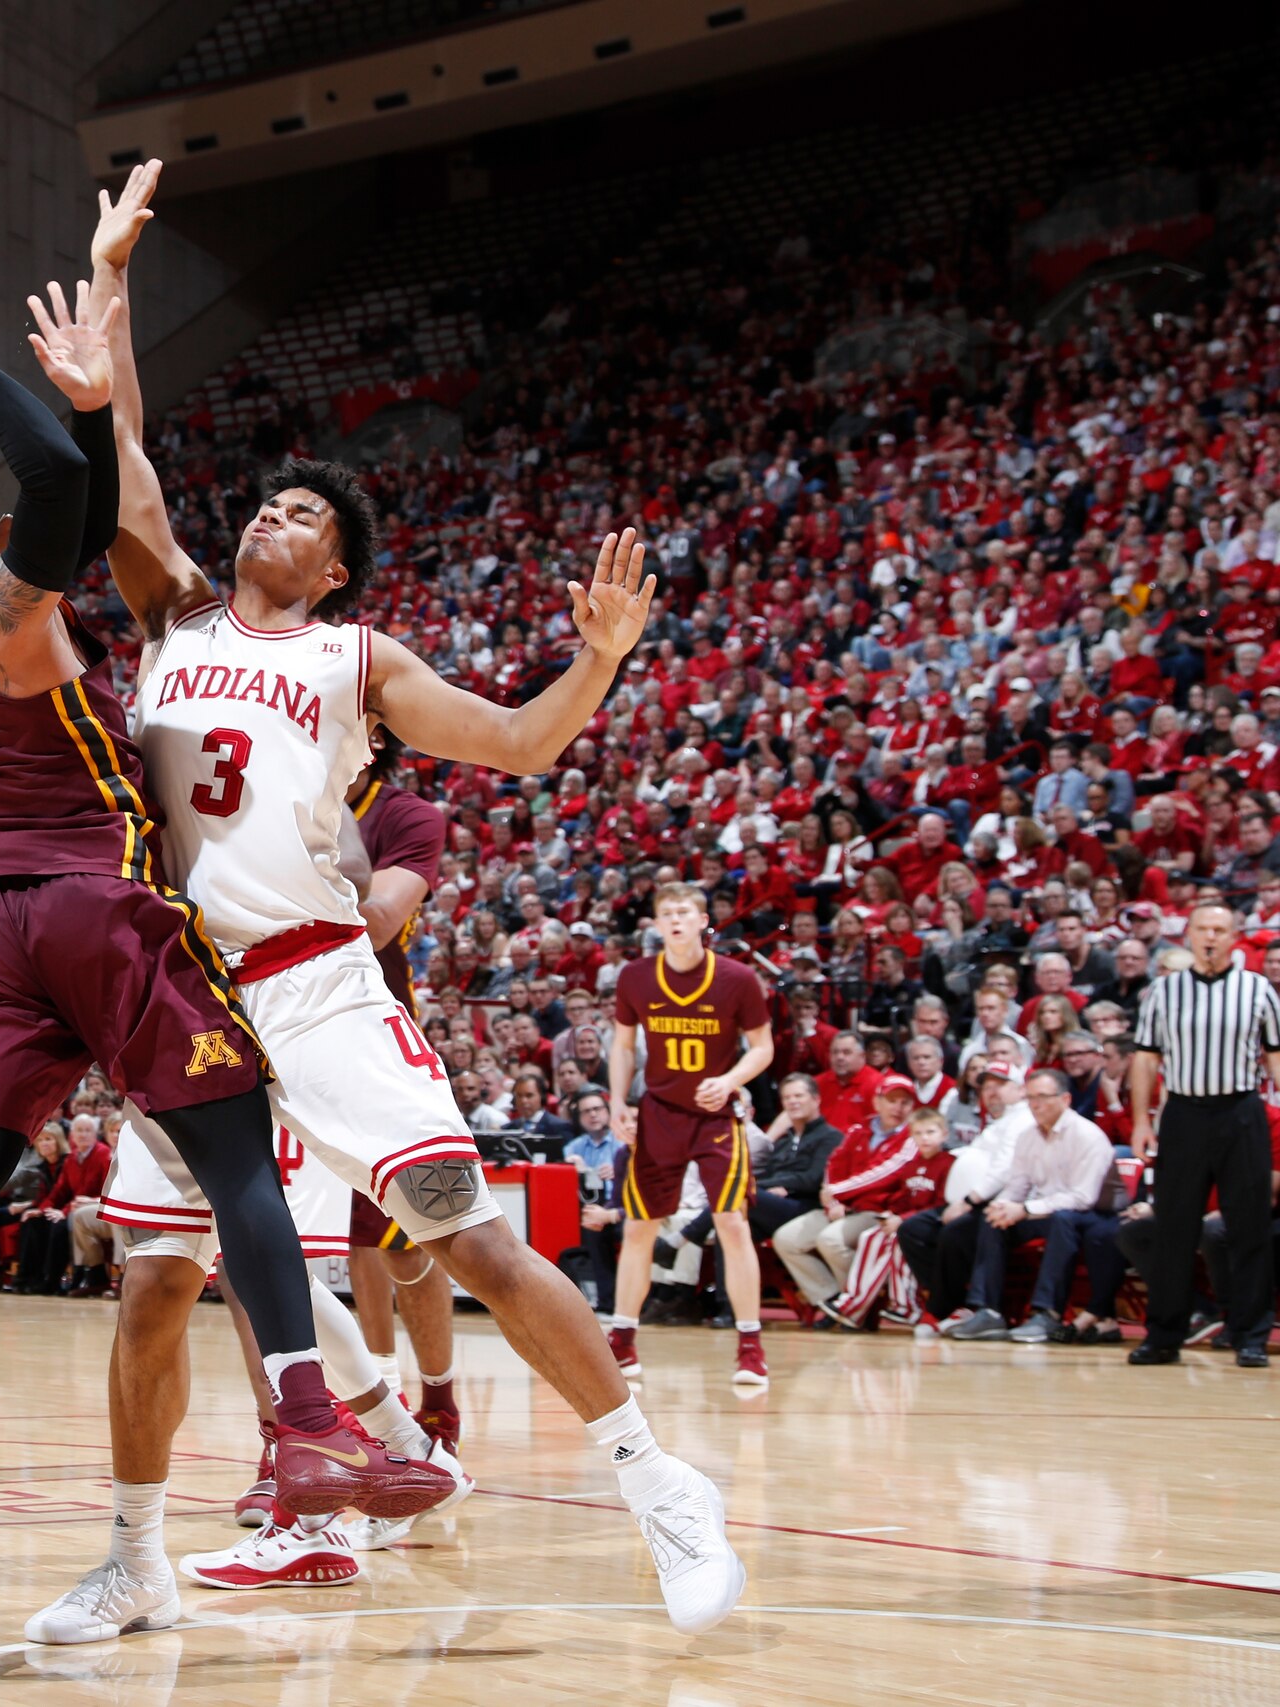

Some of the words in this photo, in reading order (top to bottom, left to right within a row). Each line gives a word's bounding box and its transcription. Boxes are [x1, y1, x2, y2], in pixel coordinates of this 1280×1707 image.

[156, 665, 321, 744] INDIANA
[190, 727, 253, 818] 3
[648, 1016, 720, 1035] MINNESOTA
[185, 1030, 243, 1077] M
[665, 1038, 705, 1072] 10
